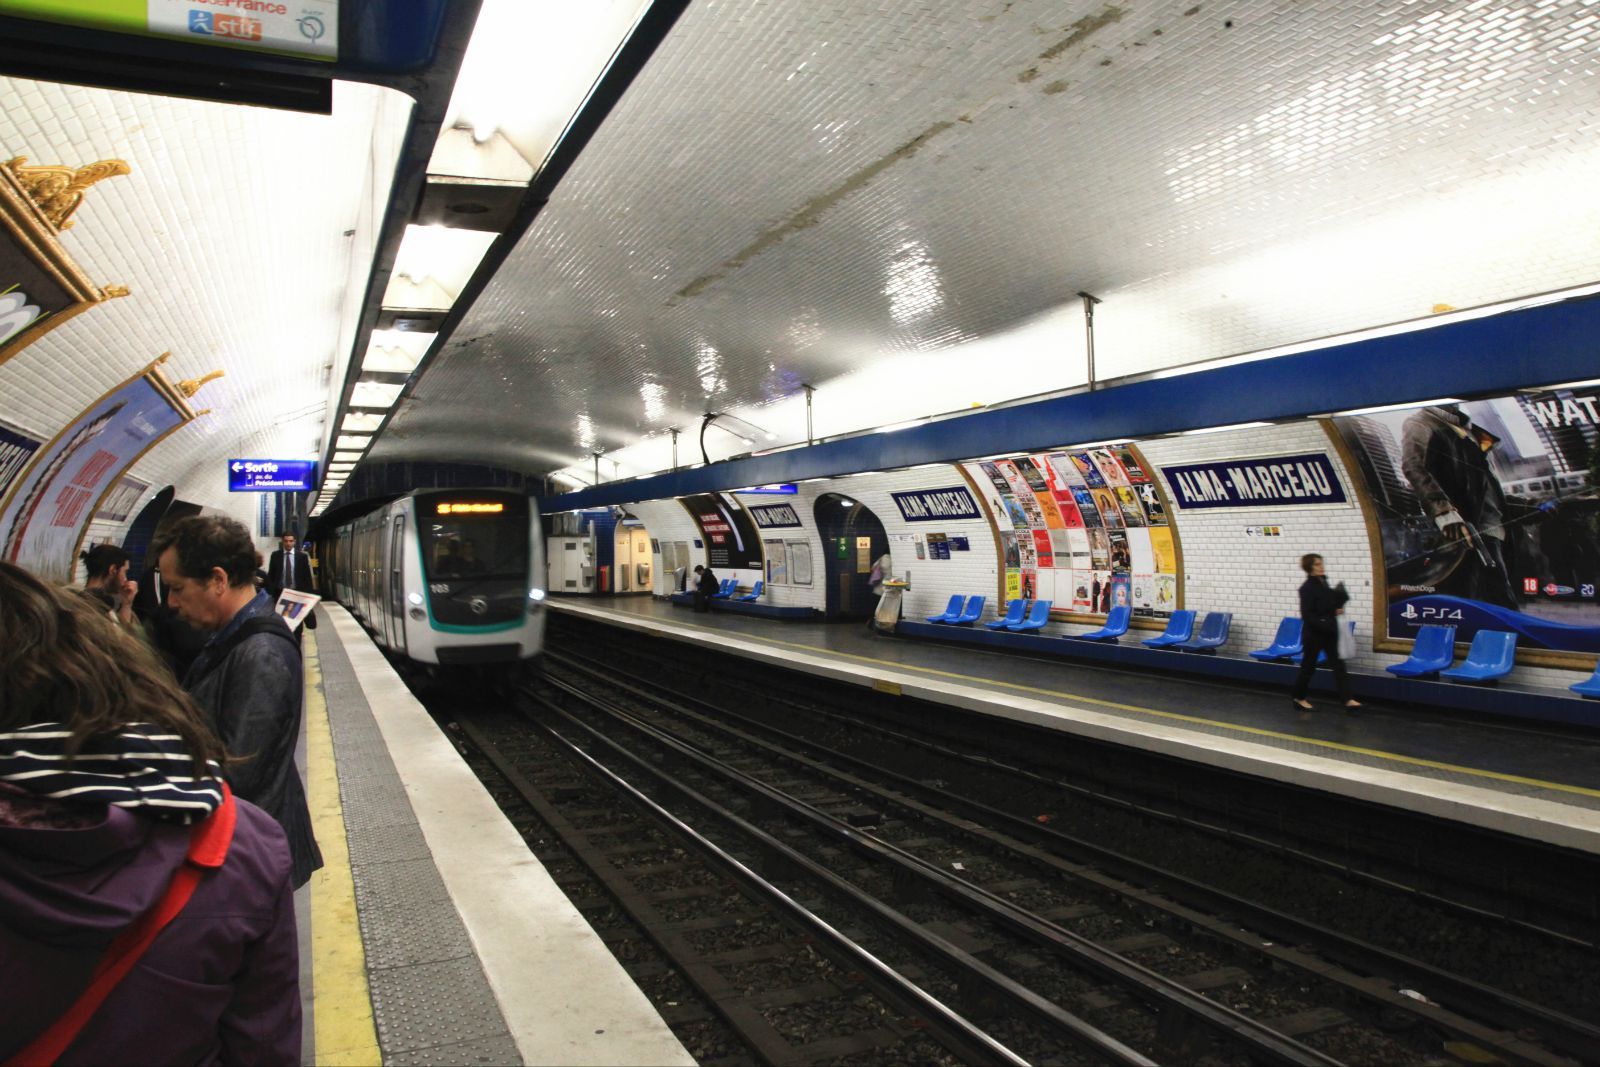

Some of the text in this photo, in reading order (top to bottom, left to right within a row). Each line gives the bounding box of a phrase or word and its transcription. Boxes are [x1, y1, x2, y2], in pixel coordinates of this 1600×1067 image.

[1526, 396, 1600, 428] WAT
[245, 462, 279, 472] Sortie
[1175, 461, 1333, 503] ALMA-MARCEAU
[897, 490, 975, 518] ALMA-MARCEAU
[1524, 578, 1537, 591] 18
[1422, 606, 1463, 620] PS4
